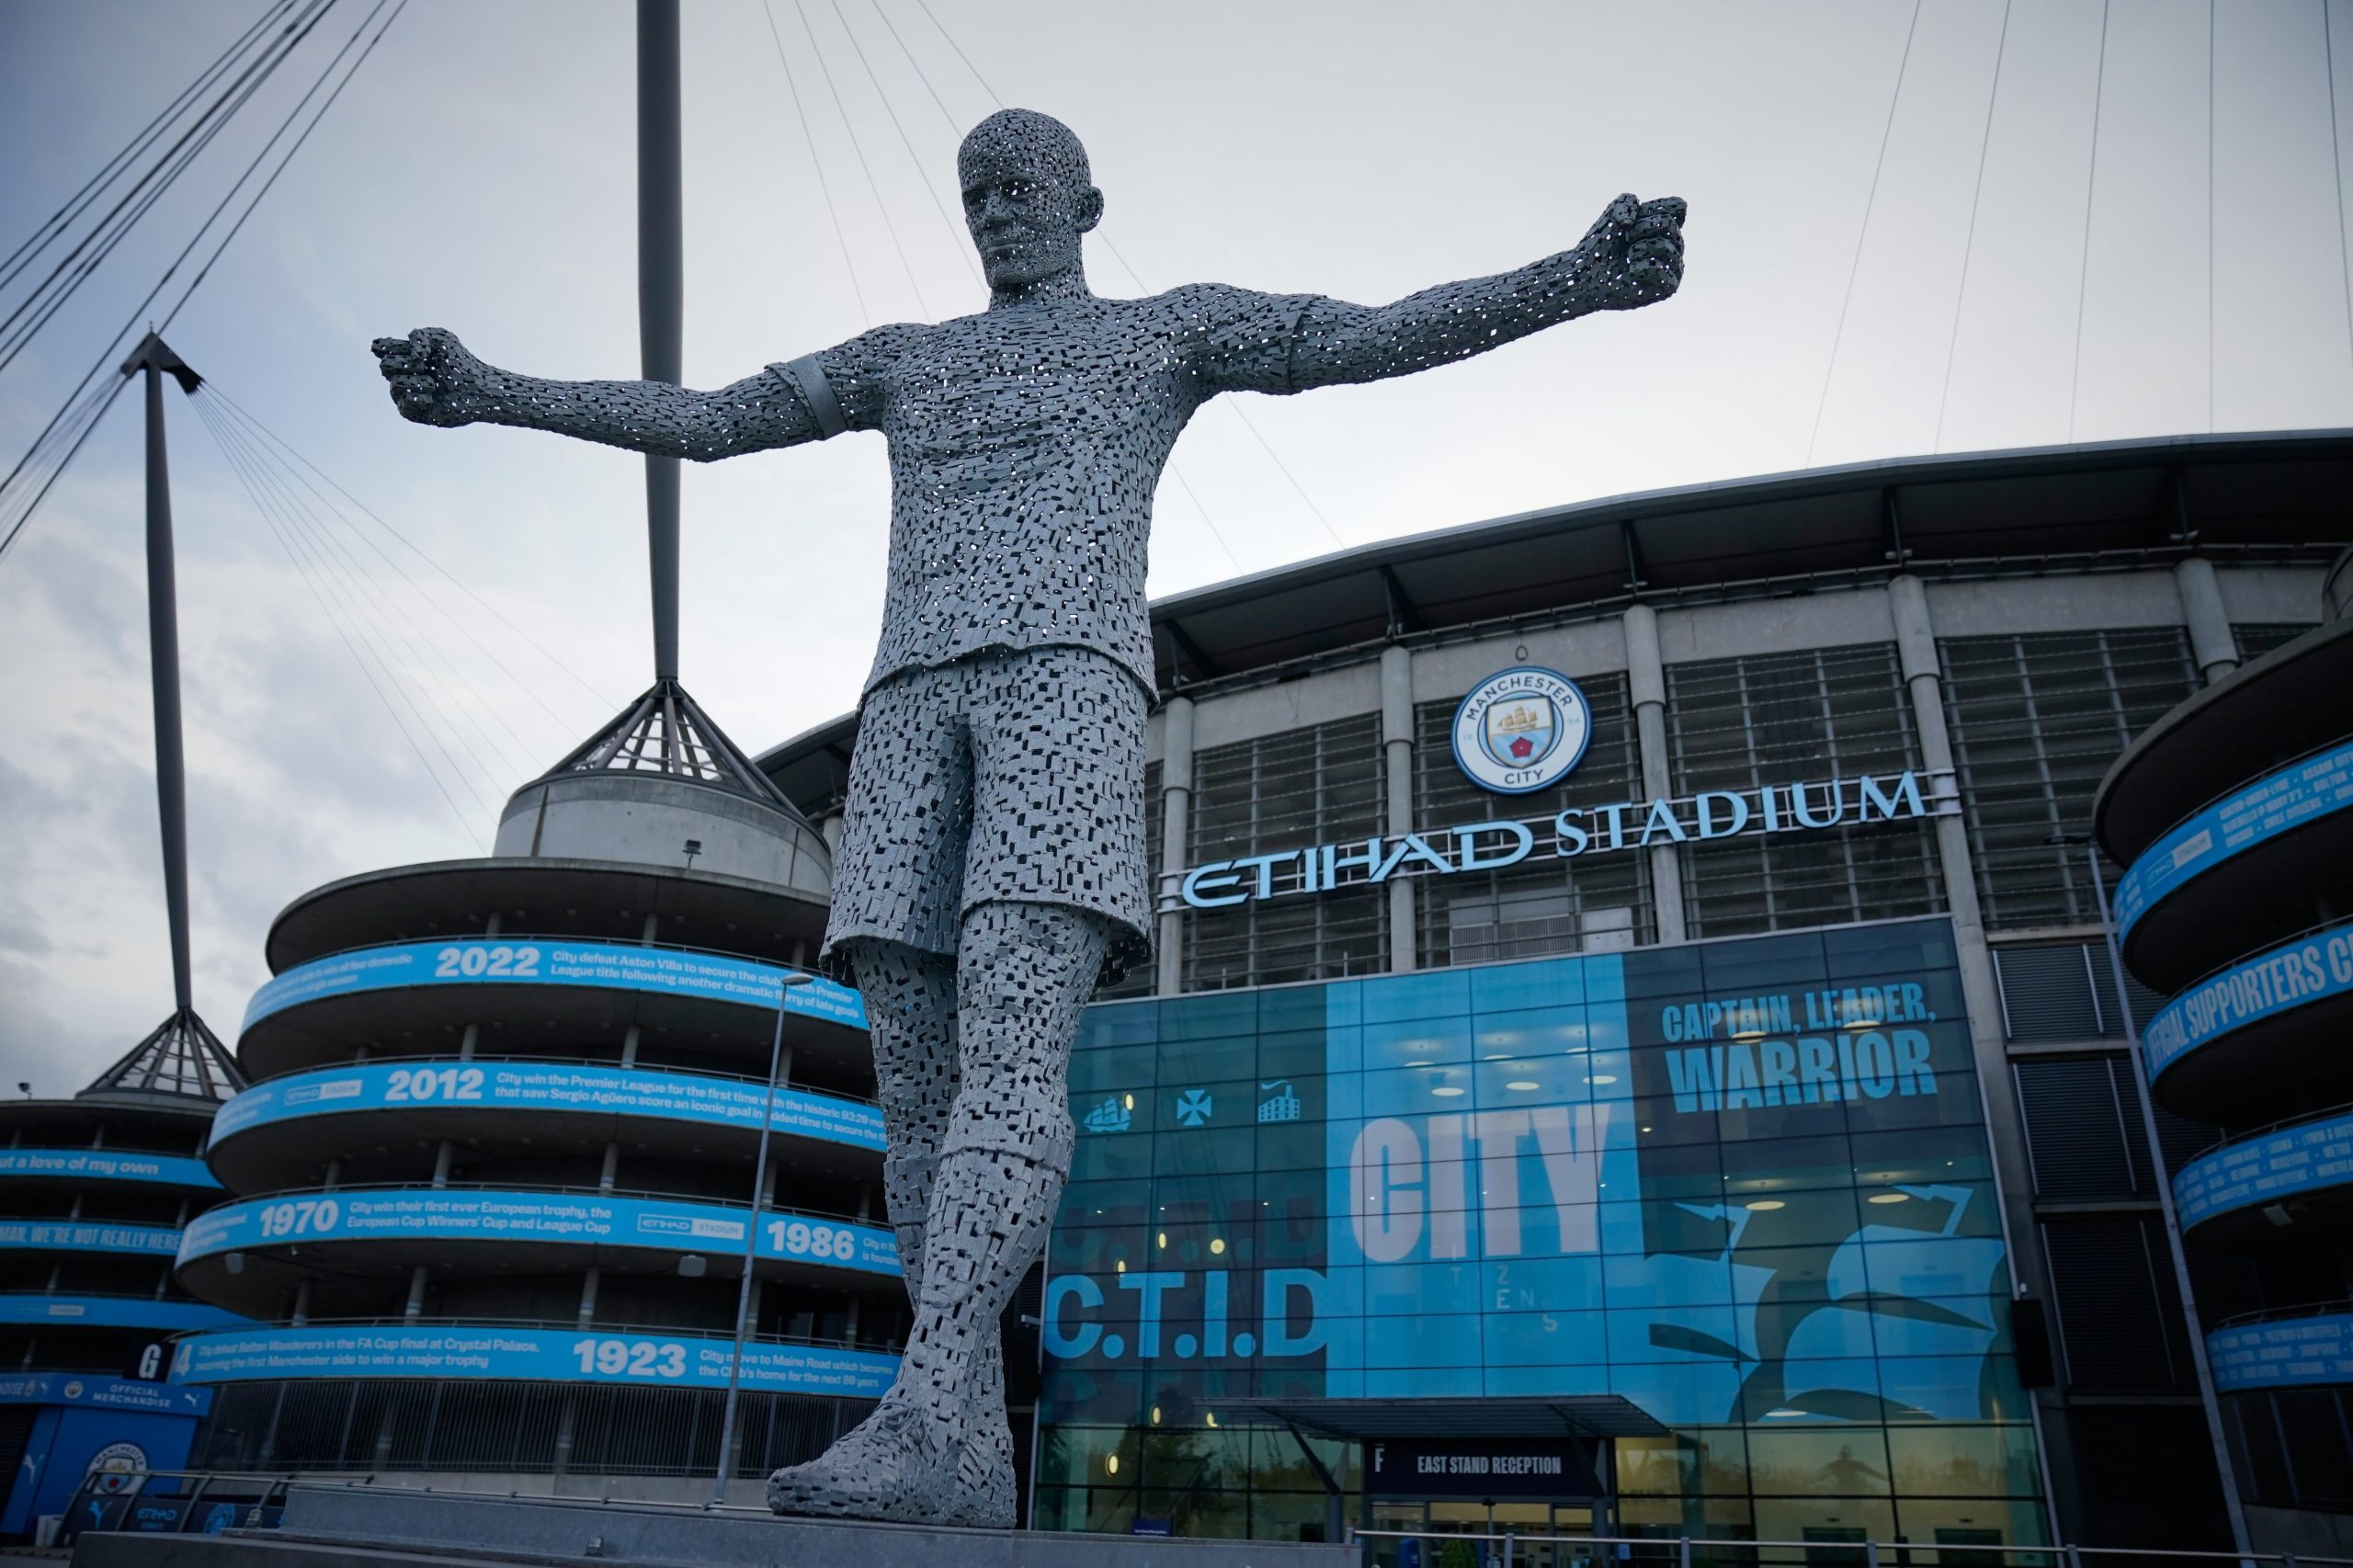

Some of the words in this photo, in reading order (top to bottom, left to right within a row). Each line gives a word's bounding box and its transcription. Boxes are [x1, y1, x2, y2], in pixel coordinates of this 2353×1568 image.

[1466, 676, 1573, 721] MANCHESTER
[1504, 768, 1544, 785] CITY
[1181, 820, 1535, 909] ETIHAD
[1554, 770, 1927, 858] STADIUM
[435, 947, 541, 977] 2022
[552, 950, 578, 965] City
[579, 952, 618, 966] defeat
[619, 955, 655, 970] Aston
[657, 959, 683, 972] Villa
[685, 963, 697, 973] to
[699, 965, 738, 980] secure
[739, 970, 757, 983] the
[816, 986, 854, 1003] Premier
[551, 964, 596, 978] League
[597, 967, 620, 979] title
[621, 969, 677, 986] following
[678, 975, 722, 991] another
[724, 982, 774, 999] dramatic
[804, 994, 816, 1007] of
[816, 998, 835, 1011] late
[835, 1005, 860, 1018] goals
[2184, 945, 2326, 1040] SUPPORTERS
[1662, 993, 1802, 1043] CAPTAIN,
[1804, 982, 1938, 1030] LEADER,
[384, 1068, 484, 1101] 2012
[1663, 1028, 1939, 1114] WARRIOR
[494, 1085, 520, 1099] that
[522, 1088, 550, 1100] saw
[550, 1088, 590, 1103] Sergio
[591, 1090, 637, 1106] Agüero
[638, 1097, 673, 1109] score
[673, 1099, 690, 1110] an
[690, 1100, 727, 1114] iconic
[727, 1106, 752, 1119] goal
[752, 1107, 764, 1119] in
[767, 1110, 799, 1126] dded
[799, 1115, 823, 1130] time
[823, 1119, 834, 1131] to
[496, 1072, 522, 1086] City
[523, 1074, 548, 1085] win
[549, 1074, 569, 1087] the
[571, 1075, 620, 1090] Premier
[621, 1079, 666, 1095] League
[667, 1083, 686, 1096] for
[687, 1085, 707, 1098] the
[708, 1087, 733, 1102] first
[733, 1090, 759, 1105] time
[760, 1096, 785, 1109] wth
[785, 1099, 803, 1113] the
[804, 1102, 840, 1119] historic
[17, 1158, 28, 1169] a
[29, 1154, 66, 1170] love
[67, 1154, 88, 1170] of
[88, 1160, 118, 1176] my
[119, 1162, 160, 1176] own
[1349, 1102, 1611, 1265] CITY
[259, 1199, 339, 1238] 1970
[347, 1215, 401, 1229] European
[401, 1214, 426, 1229] Cup
[426, 1215, 482, 1228] Winners'
[482, 1216, 509, 1231] Cup
[509, 1219, 535, 1230] and
[536, 1219, 584, 1233] League
[584, 1221, 611, 1235] Cup
[349, 1201, 372, 1215] City
[373, 1201, 395, 1212] win
[395, 1200, 423, 1212] their
[424, 1200, 450, 1213] first
[451, 1202, 480, 1213] ever
[481, 1201, 542, 1217] European
[543, 1204, 589, 1220] trophy,
[590, 1207, 613, 1219] the
[30, 1226, 73, 1244] WE'RE
[74, 1228, 100, 1245] NOT
[100, 1229, 147, 1248] REALLY
[642, 1219, 691, 1231] ETIHAD
[699, 1221, 740, 1236] STADIUM
[767, 1221, 855, 1260] 1986
[863, 1237, 880, 1251] City
[1041, 1267, 1327, 1360] C.T.I.D
[268, 1340, 324, 1354] Wanderers
[324, 1339, 336, 1350] in
[336, 1338, 357, 1350] the
[357, 1337, 373, 1350] FA
[374, 1337, 399, 1352] Cup
[400, 1337, 427, 1350] final
[428, 1339, 442, 1350] at
[444, 1337, 492, 1353] Crystal
[493, 1338, 540, 1354] Palace,
[573, 1338, 688, 1378] 1923
[699, 1349, 725, 1365] City
[759, 1354, 771, 1366] to
[773, 1354, 805, 1368] Maine
[806, 1357, 832, 1369] Road
[832, 1359, 859, 1372] which
[139, 1344, 162, 1380] G
[267, 1356, 331, 1368] Manchester
[332, 1354, 357, 1366] side
[358, 1354, 371, 1366] to
[371, 1354, 395, 1366] win
[396, 1356, 404, 1366] a
[405, 1353, 444, 1368] major
[445, 1355, 490, 1369] trophy
[699, 1365, 720, 1378] the
[720, 1366, 755, 1380] Clb's
[756, 1368, 788, 1381] home
[788, 1370, 802, 1382] for
[803, 1371, 821, 1383] the
[821, 1375, 842, 1385] next
[92, 1392, 173, 1409] MERCHANDISE
[109, 1383, 160, 1398] OFFICIAL
[1374, 1447, 1386, 1473] F
[1417, 1455, 1448, 1474] EAST
[1449, 1456, 1490, 1474] STAND
[1492, 1456, 1563, 1475] RECEPTION
[136, 1507, 178, 1522] ETIHAD
